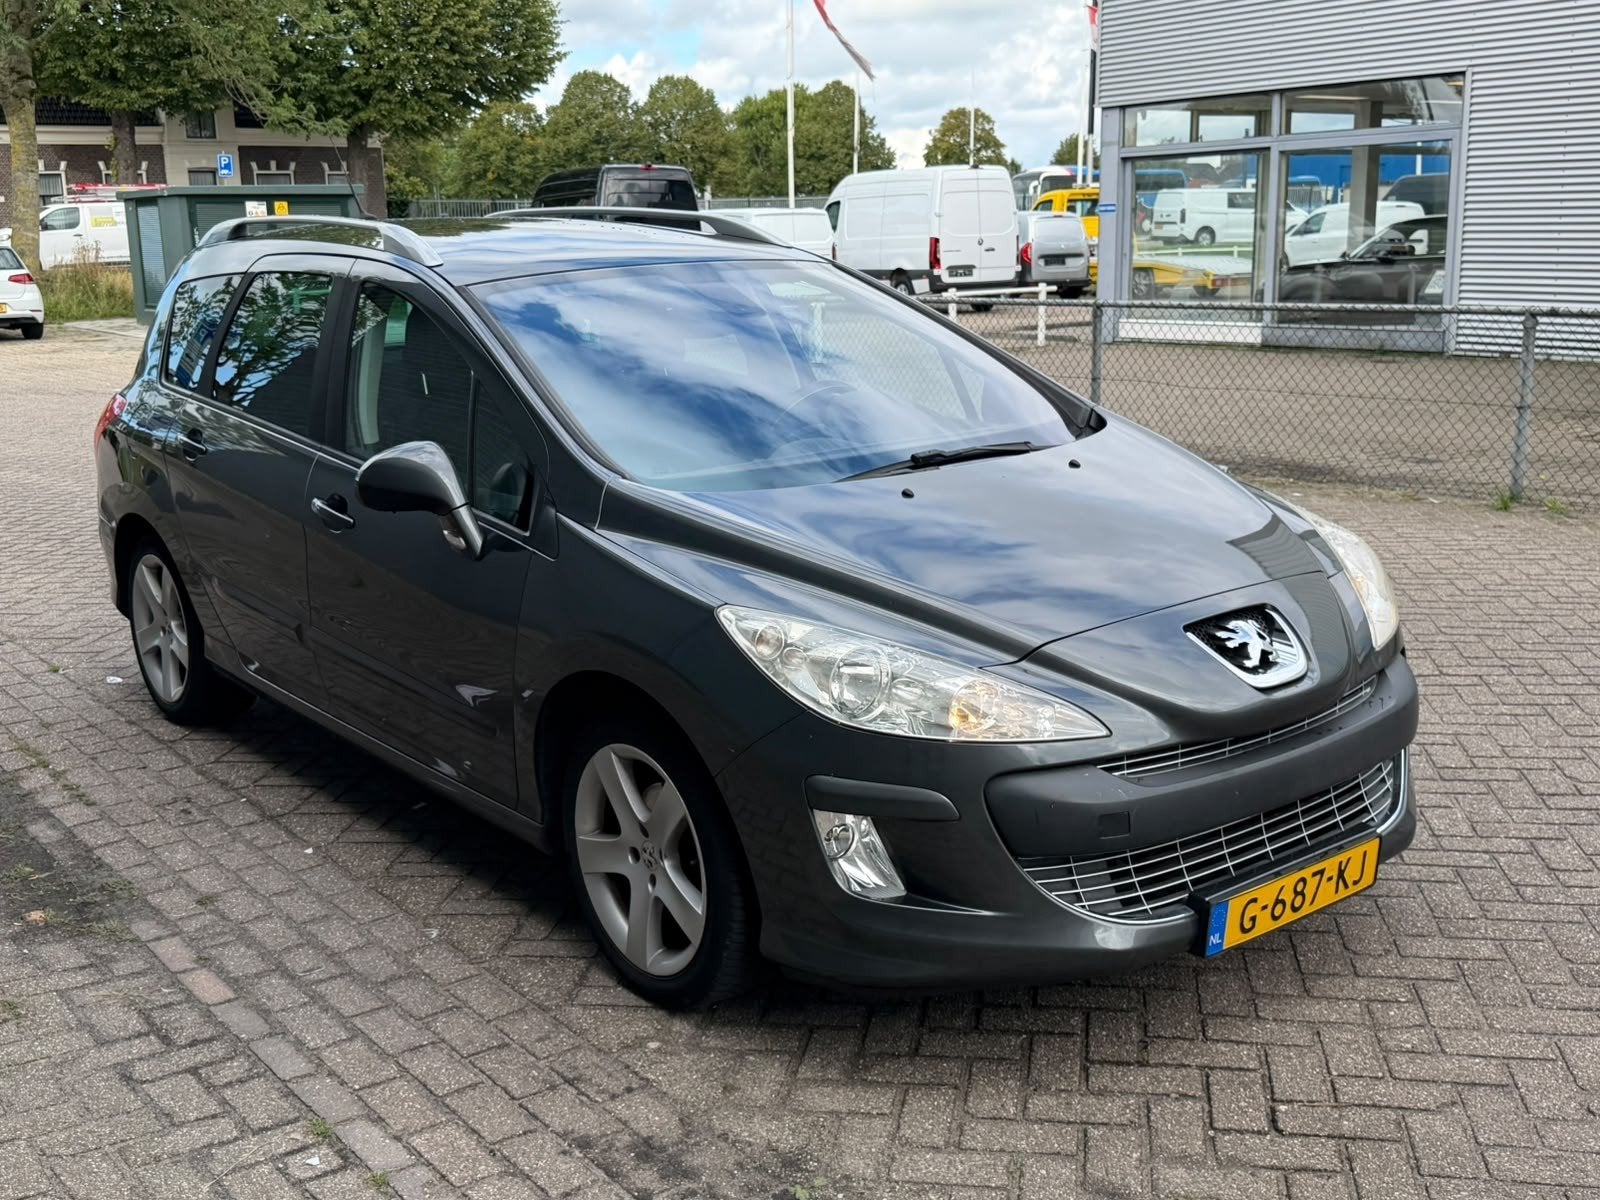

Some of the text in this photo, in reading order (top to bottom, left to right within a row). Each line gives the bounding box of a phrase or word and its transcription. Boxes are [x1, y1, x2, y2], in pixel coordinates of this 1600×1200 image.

[221, 157, 229, 168] P
[1239, 850, 1367, 935] G-687-KJ
[1208, 932, 1222, 946] NL
